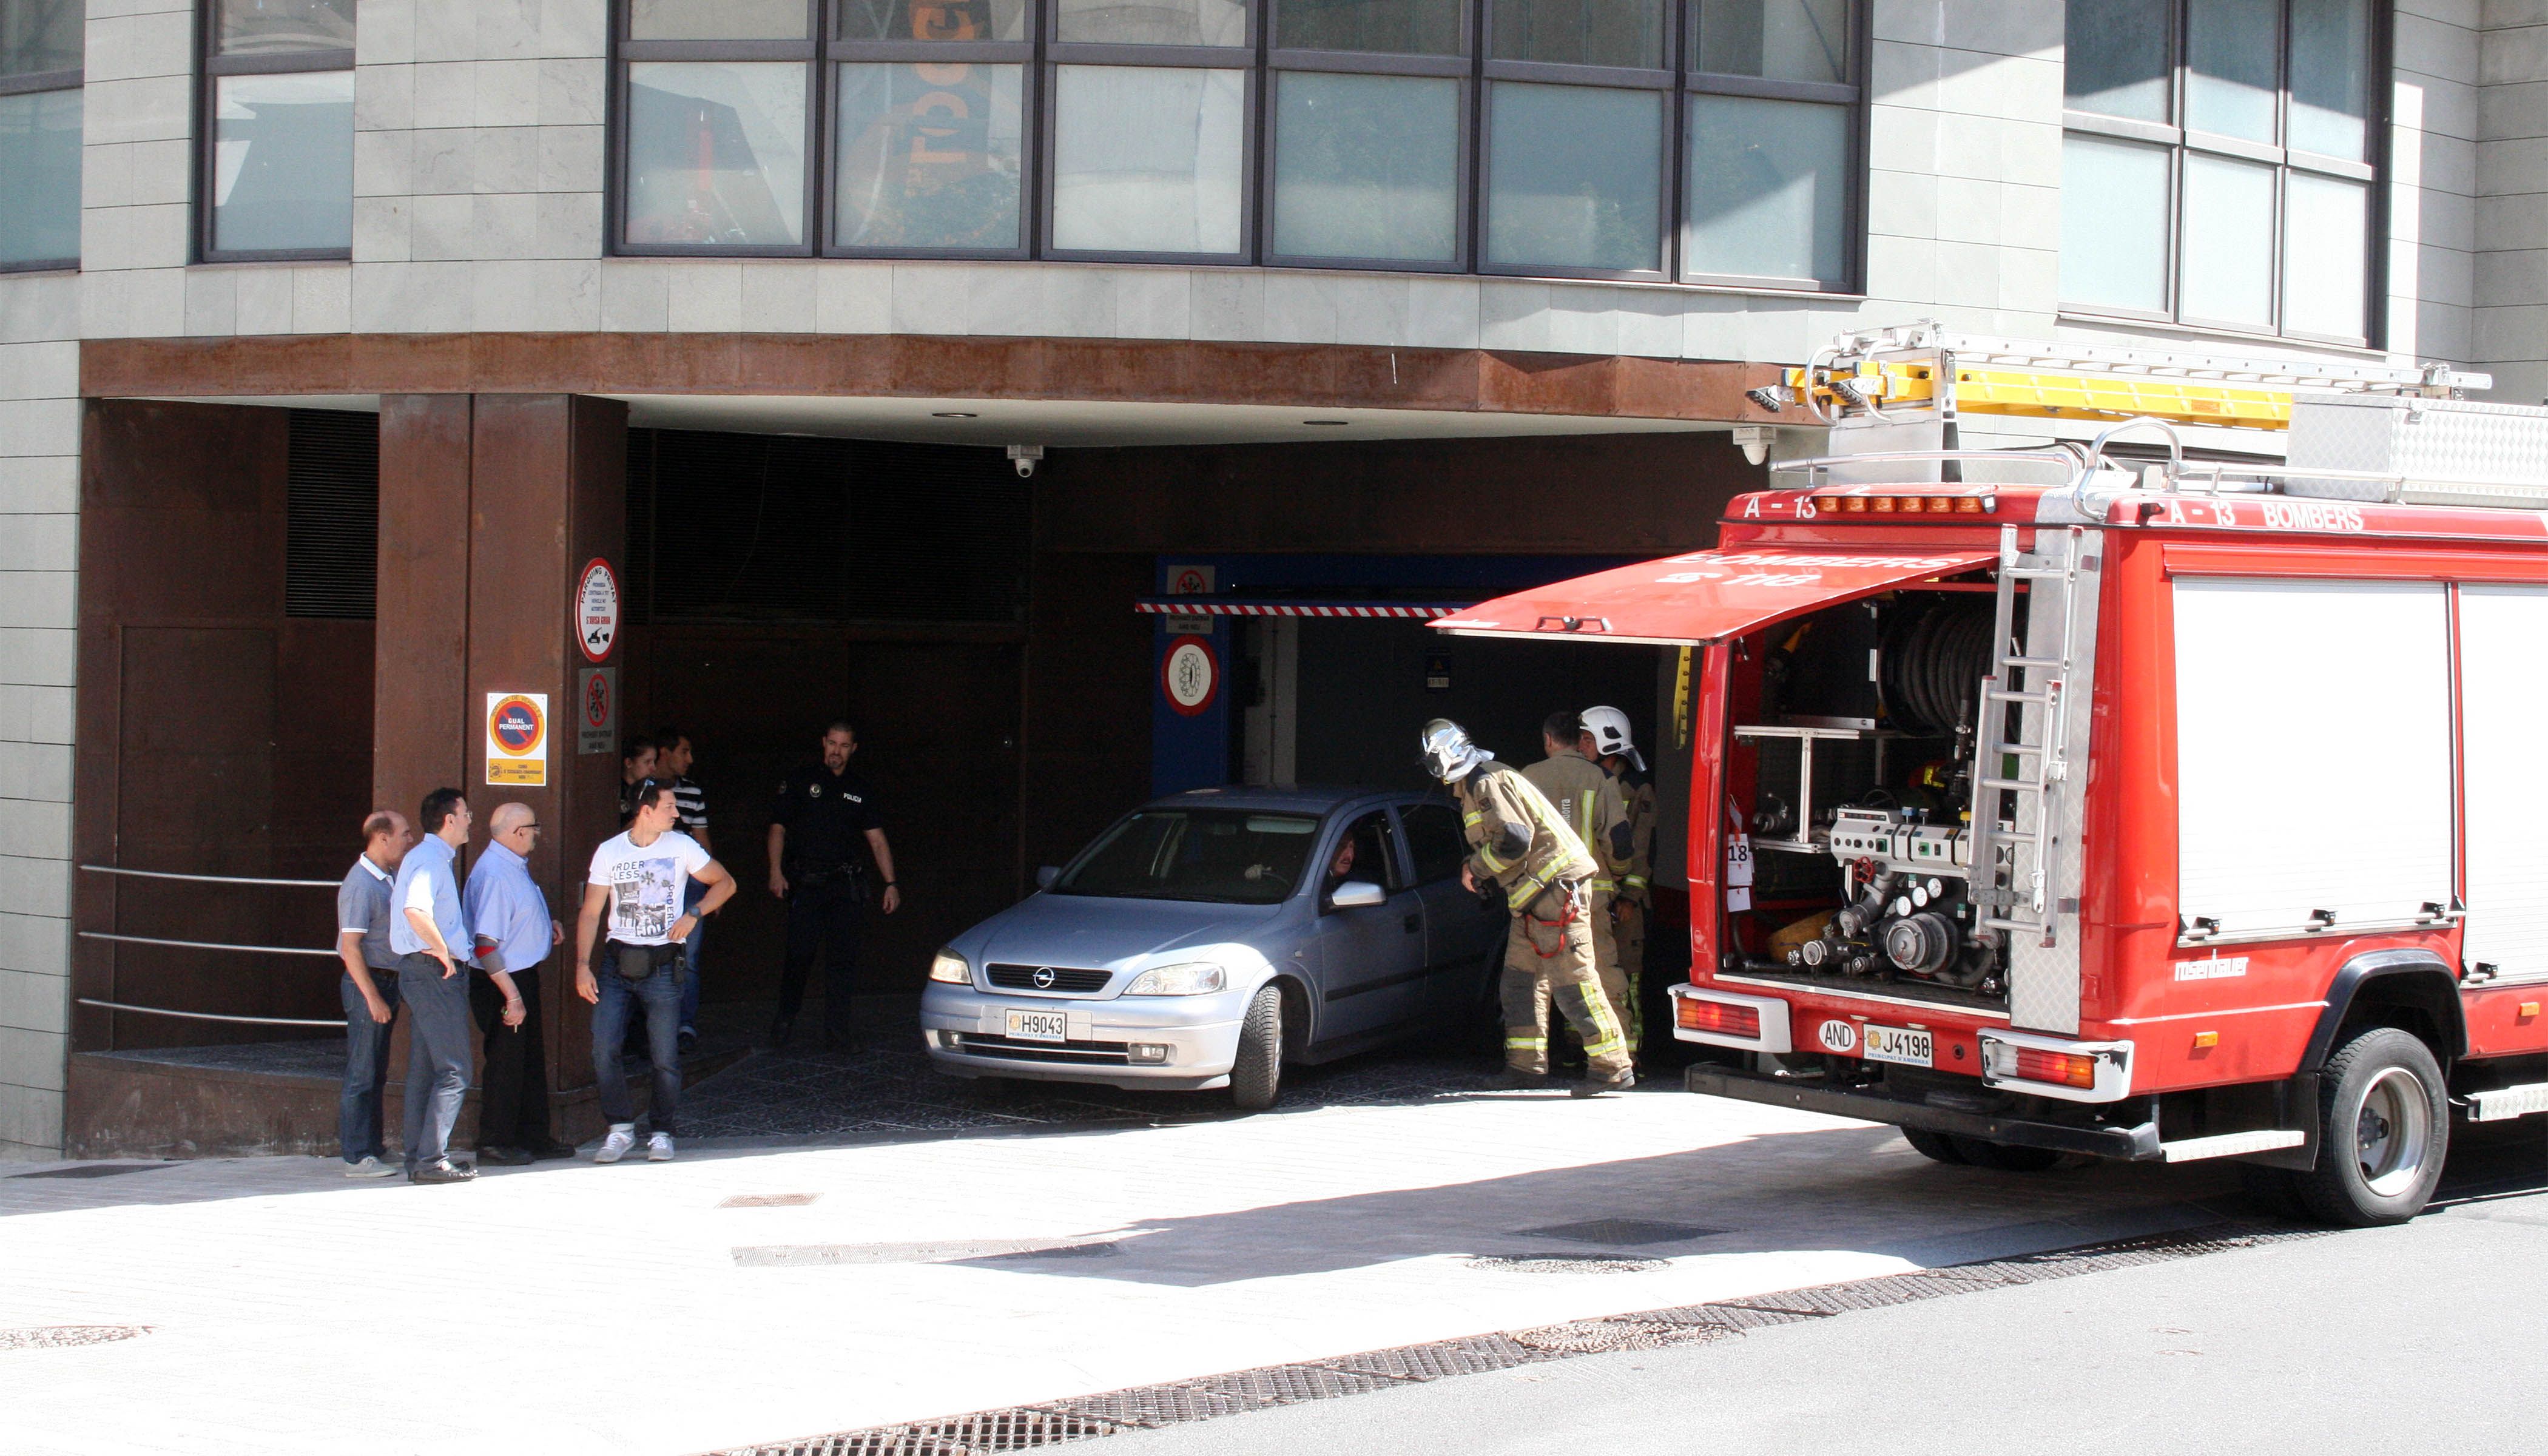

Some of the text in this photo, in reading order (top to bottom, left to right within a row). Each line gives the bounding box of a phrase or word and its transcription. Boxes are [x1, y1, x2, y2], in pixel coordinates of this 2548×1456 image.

[1744, 496, 1760, 518] A
[1794, 496, 1816, 519] 13
[2170, 500, 2186, 524] A
[2210, 501, 2236, 526] 13
[2261, 502, 2364, 531] BOMBERS
[1662, 554, 1963, 568] BOMBERS
[1722, 573, 1822, 587] 118
[1728, 845, 1748, 861] 18
[2175, 948, 2249, 982] rosenbauer
[1022, 1014, 1063, 1034] H9043
[1825, 1023, 1852, 1048] AND
[1883, 1032, 1930, 1058] J4198
[1868, 1052, 1897, 1062] PRINCIPAT
